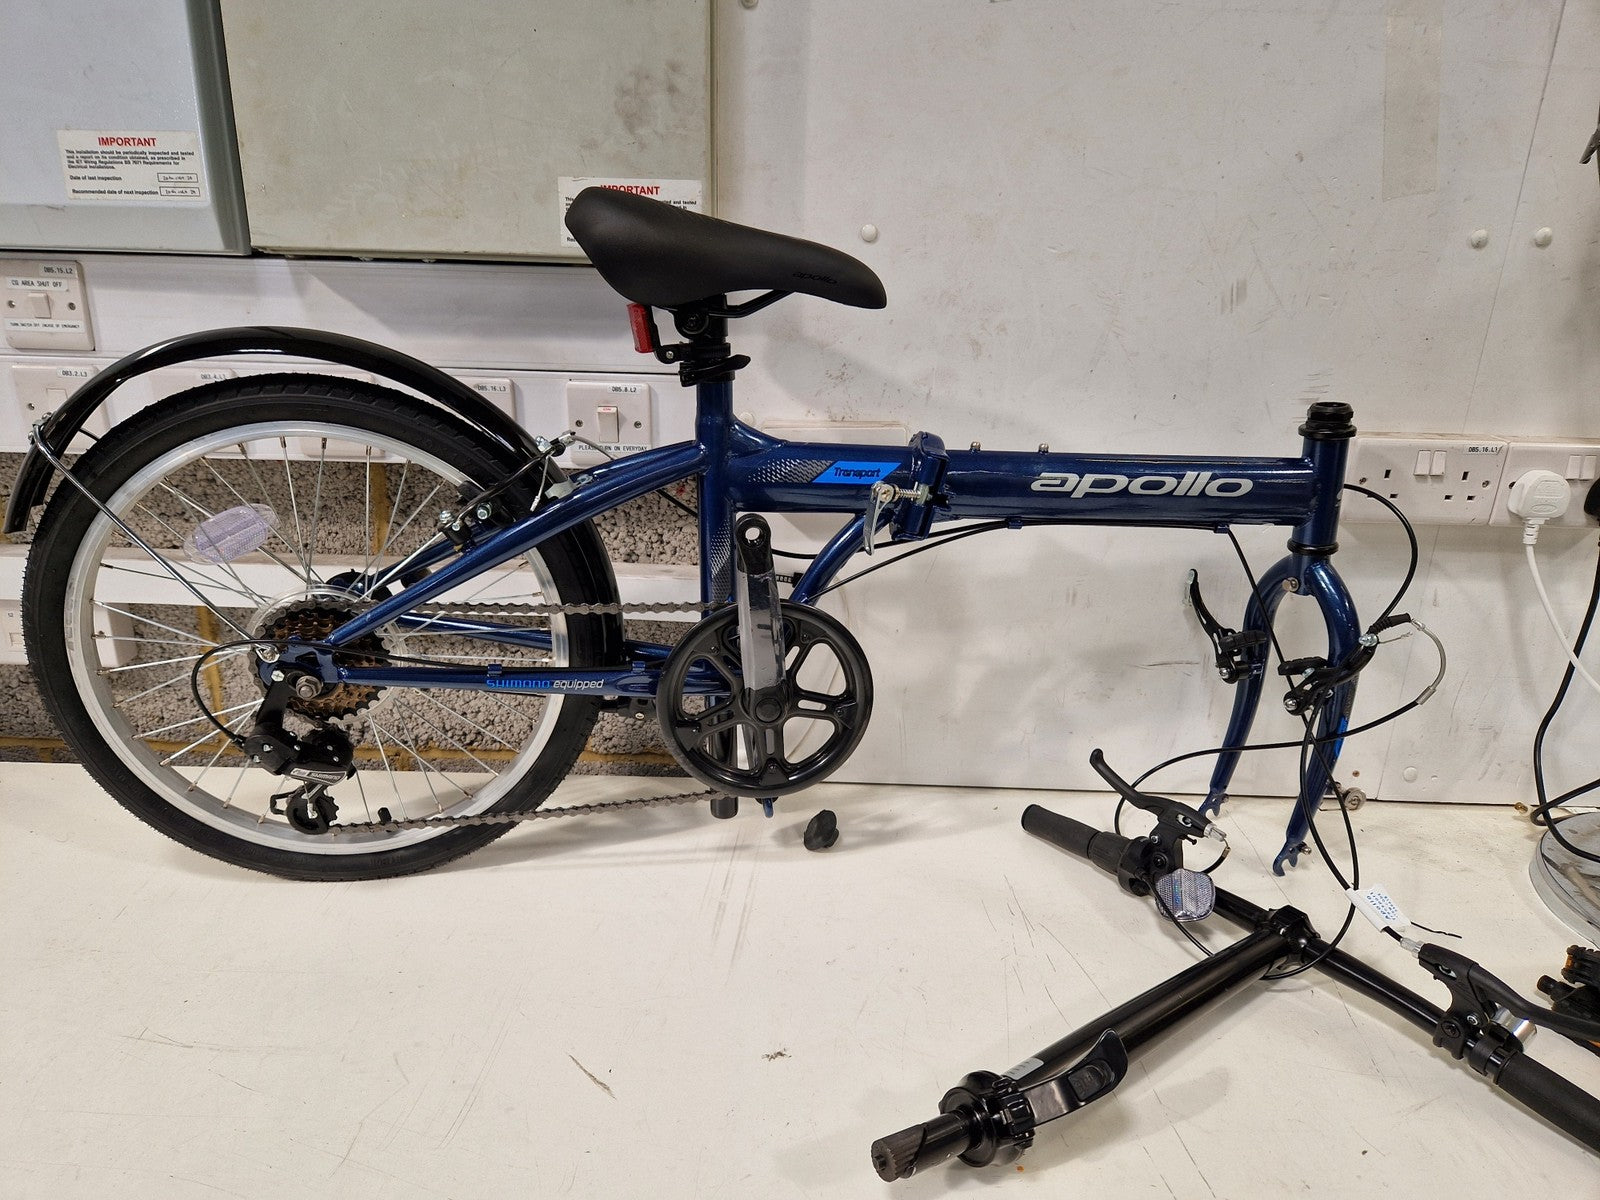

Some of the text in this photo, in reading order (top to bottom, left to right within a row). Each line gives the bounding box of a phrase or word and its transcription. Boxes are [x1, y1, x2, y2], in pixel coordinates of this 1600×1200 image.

[98, 137, 156, 146] IMPORTANT
[600, 185, 660, 195] PORTANT
[793, 272, 837, 284] apollo
[834, 467, 881, 478] Transport
[1030, 471, 1254, 498] apollo
[486, 679, 604, 690] SHIMANO equipped
